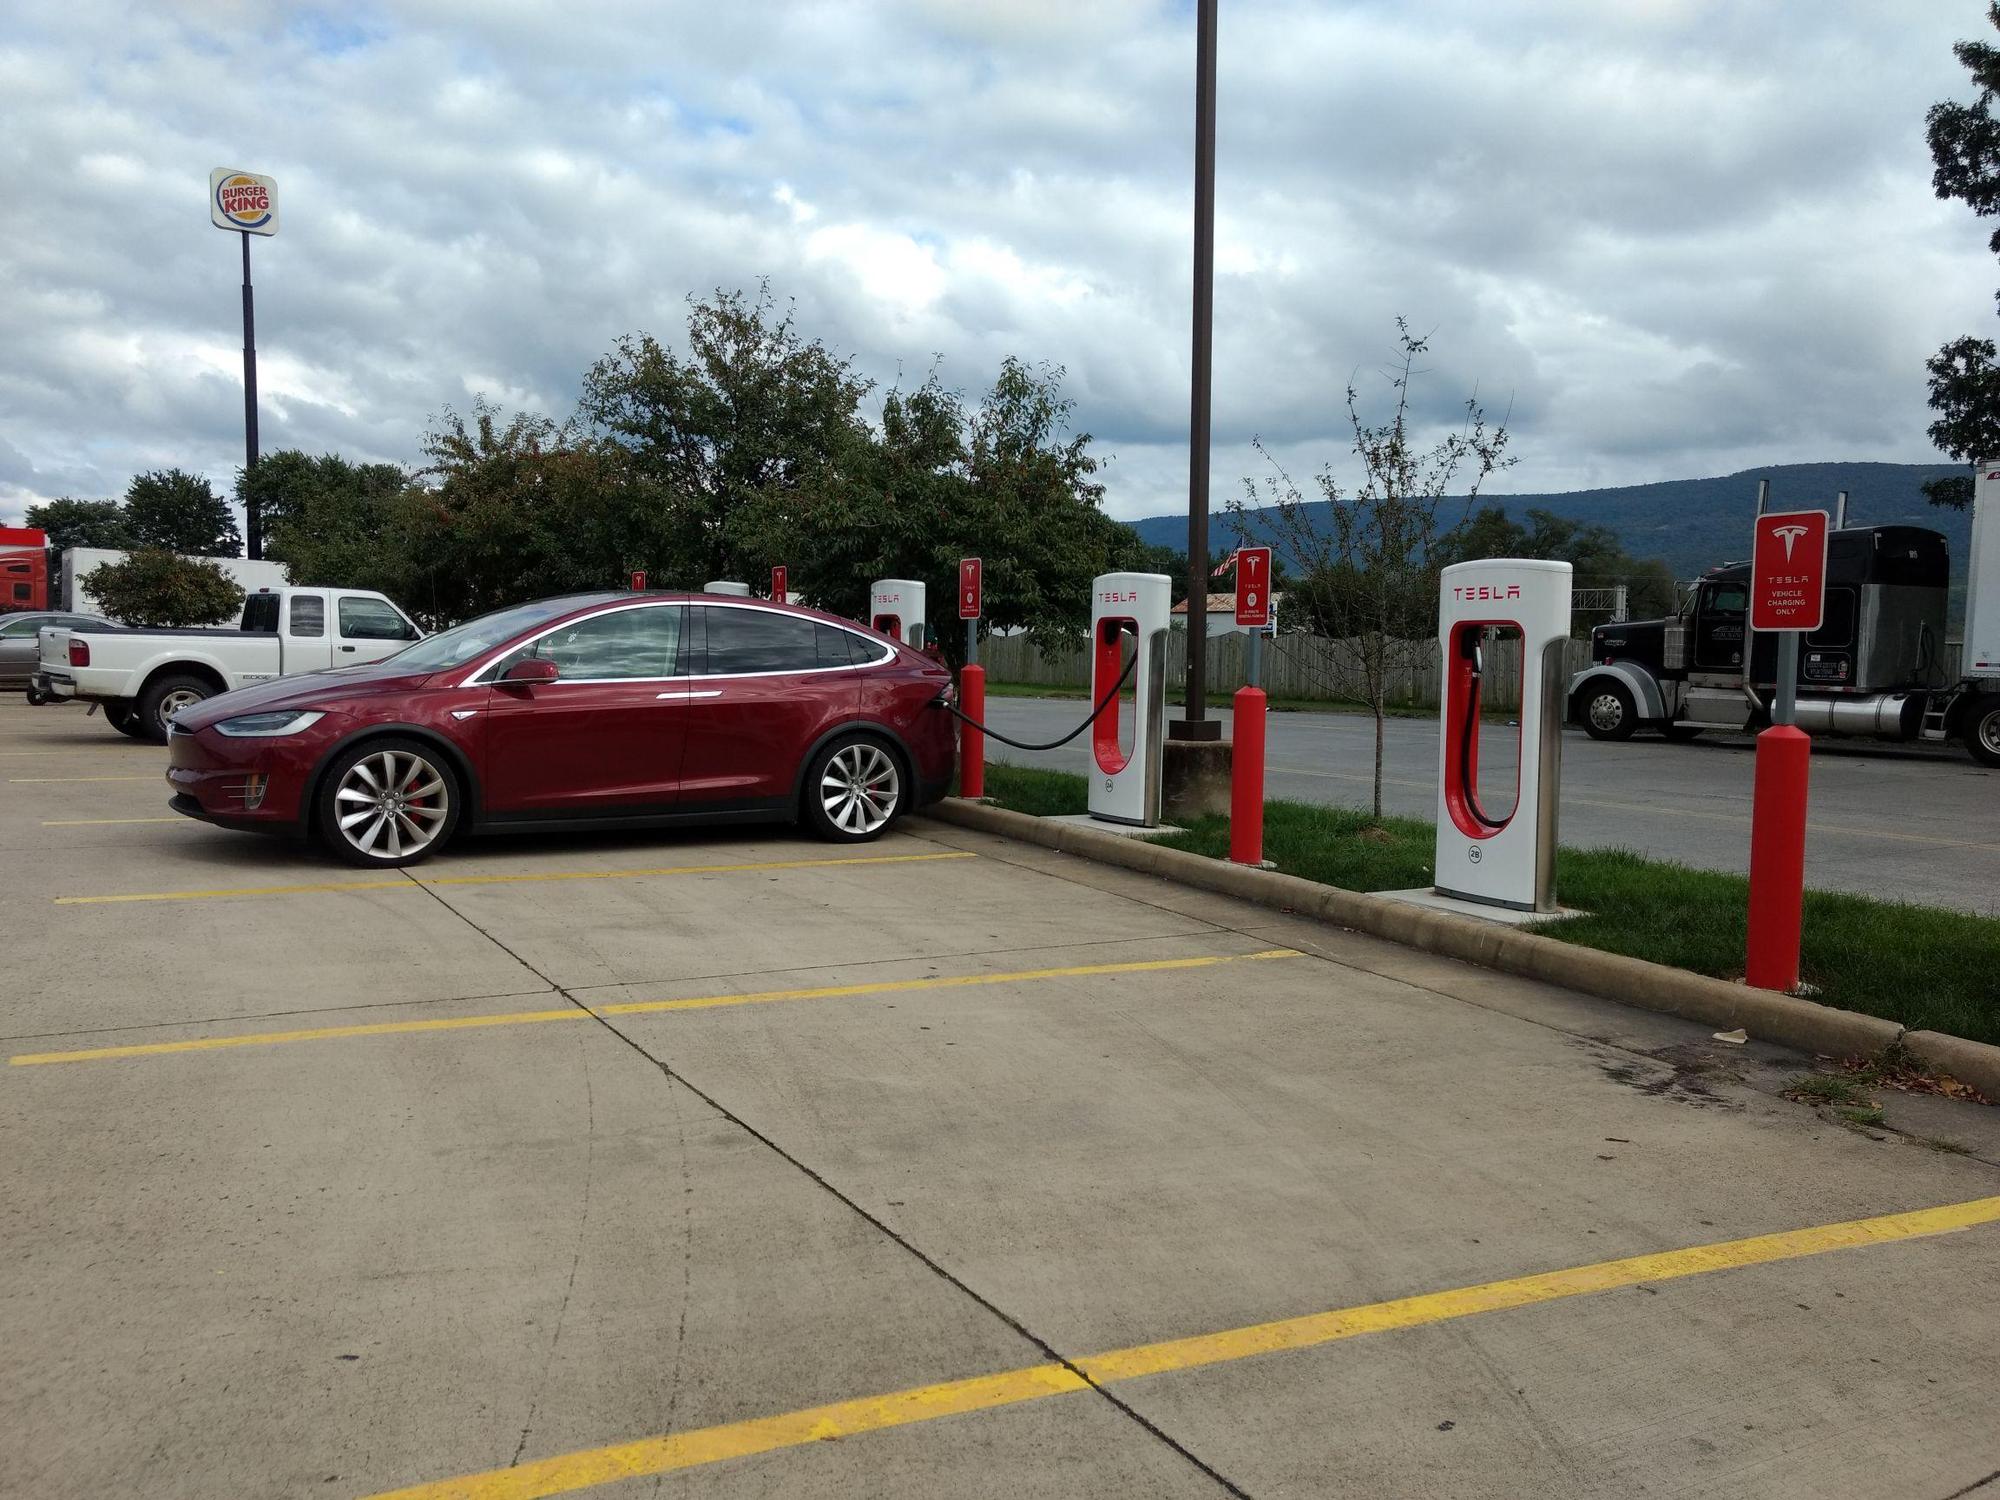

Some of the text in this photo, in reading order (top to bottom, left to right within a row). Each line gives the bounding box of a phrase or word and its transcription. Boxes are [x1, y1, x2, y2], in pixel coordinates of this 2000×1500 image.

[222, 186, 267, 200] BURGER
[224, 196, 269, 213] KING
[1767, 576, 1809, 584] TESLA
[1098, 592, 1136, 602] TESLA
[1453, 585, 1520, 600] TESLA
[874, 594, 899, 603] TESLA
[1767, 599, 1806, 607] CHARGING
